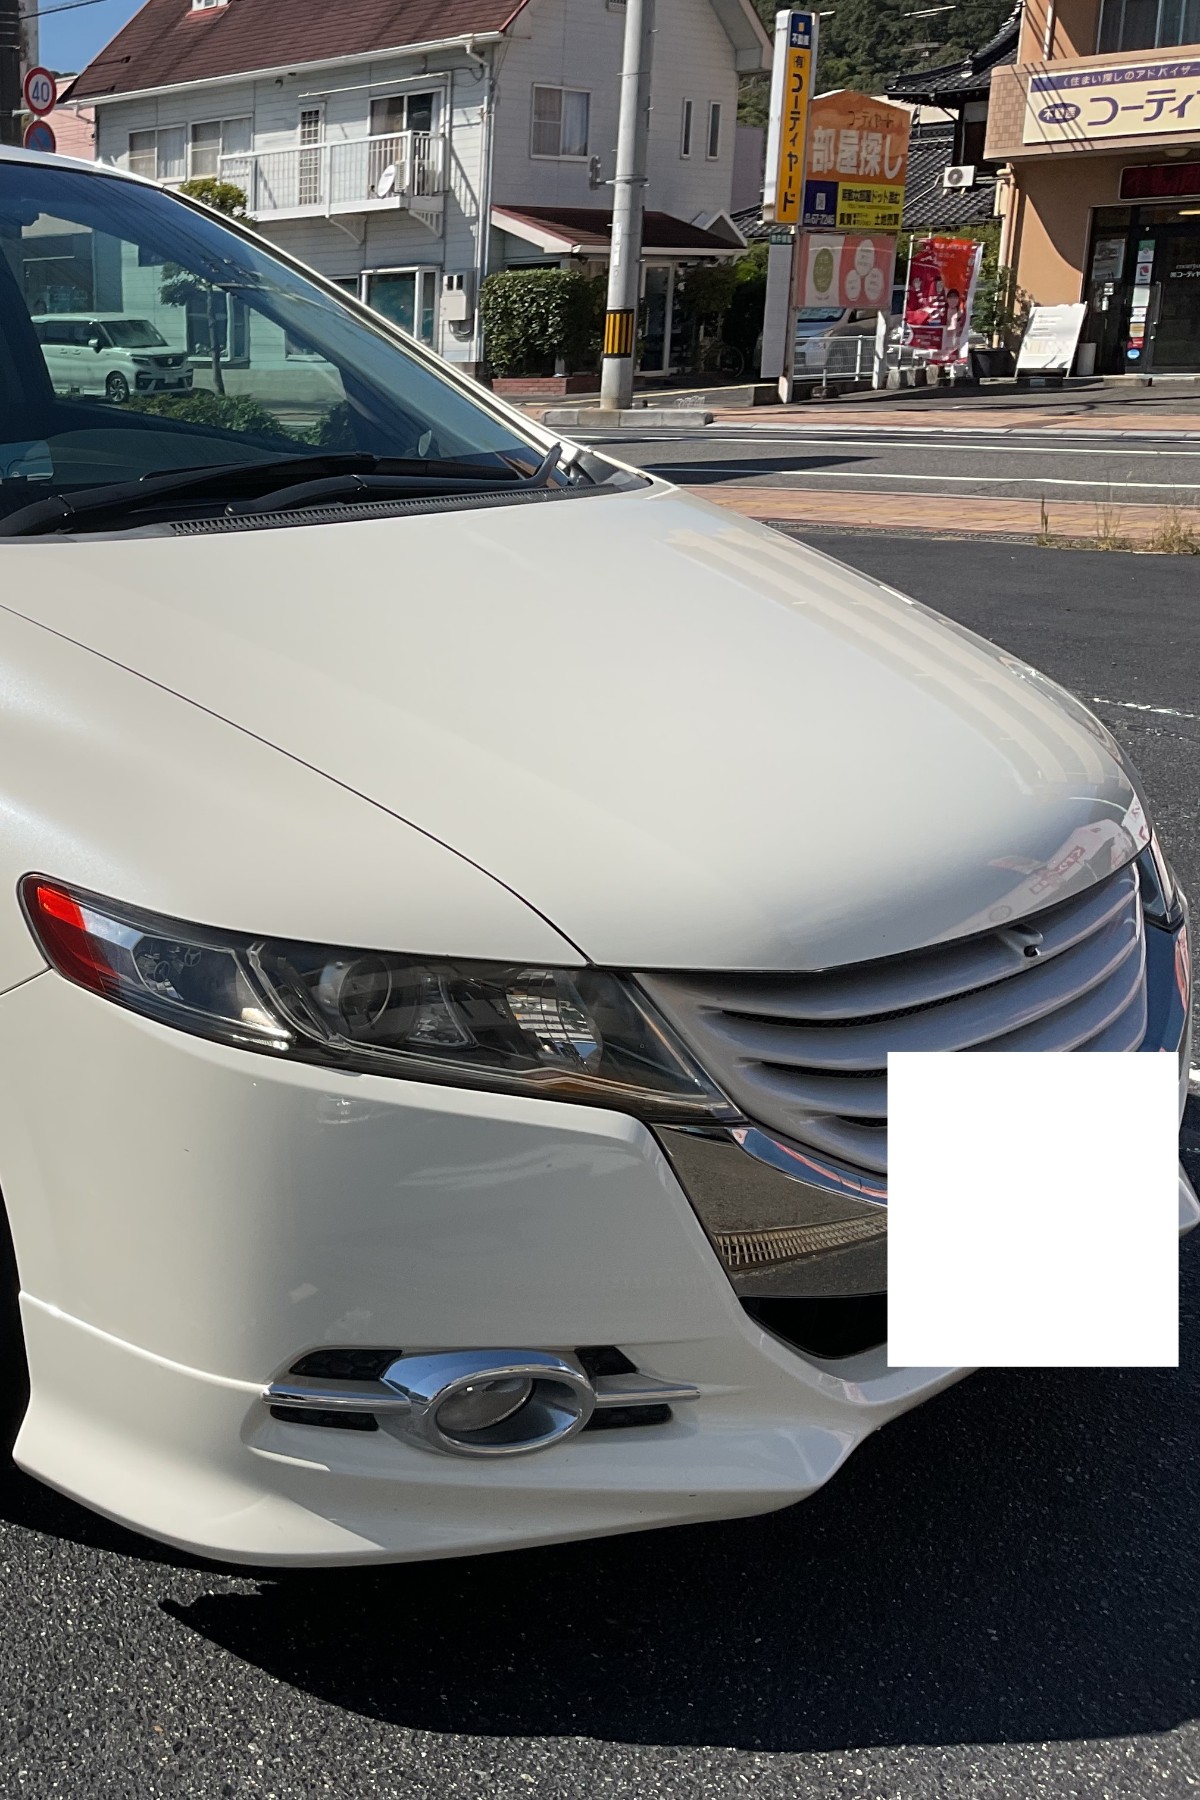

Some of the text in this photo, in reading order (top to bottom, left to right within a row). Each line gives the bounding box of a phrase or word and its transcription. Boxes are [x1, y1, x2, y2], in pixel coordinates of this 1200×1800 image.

[31, 80, 51, 102] 40
[1087, 88, 1200, 127] コーティ
[811, 125, 903, 179] 部屋探し
